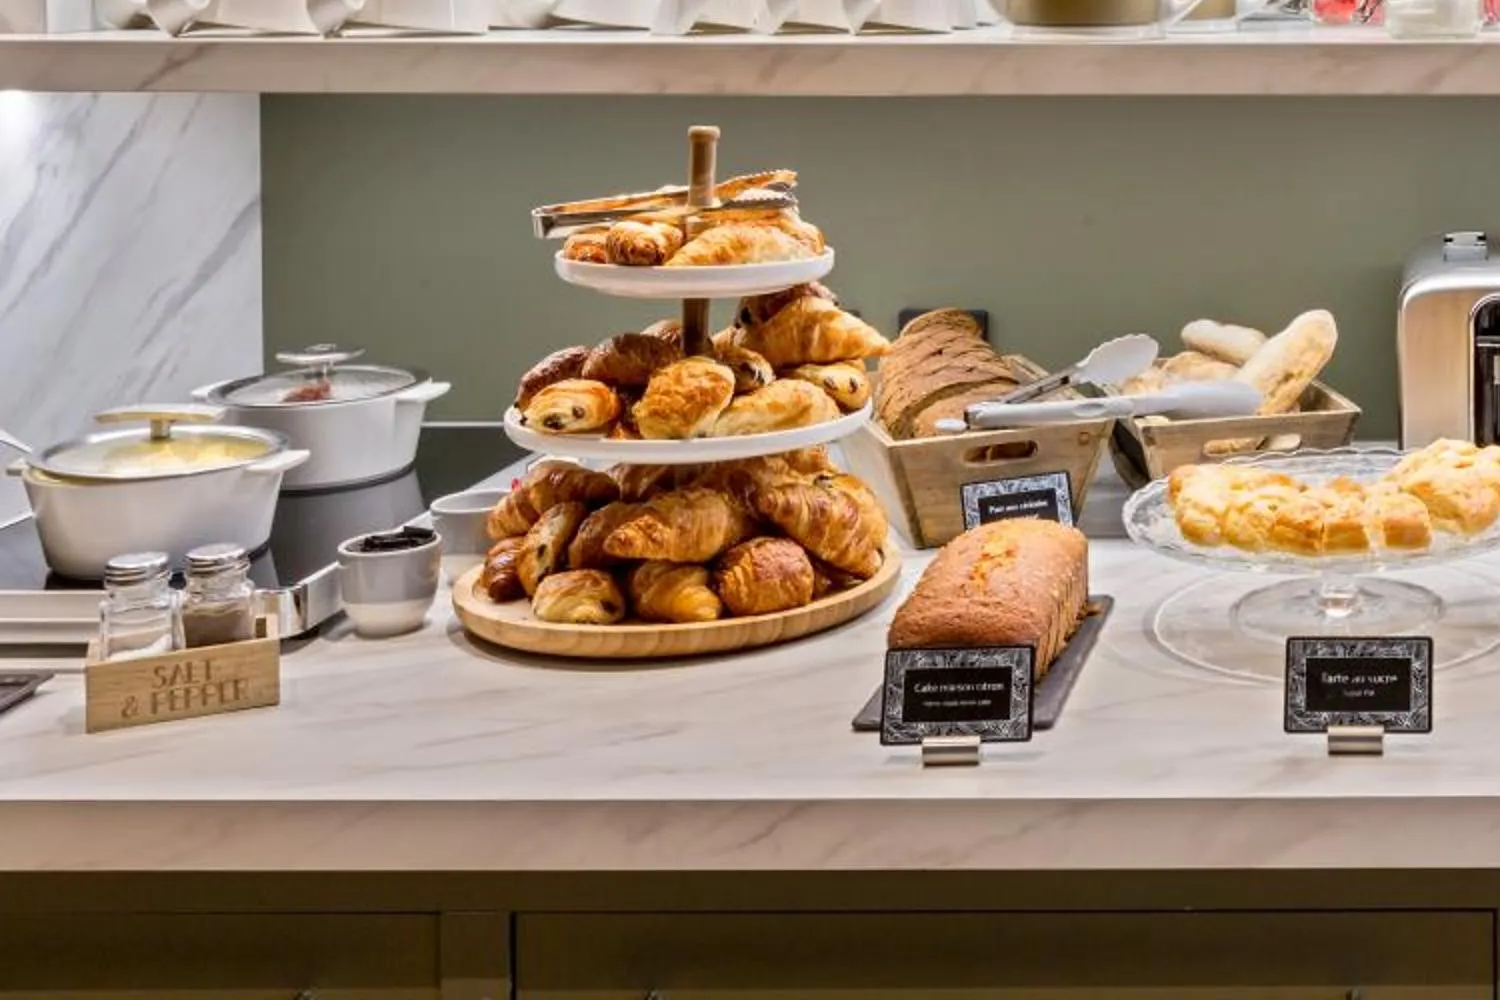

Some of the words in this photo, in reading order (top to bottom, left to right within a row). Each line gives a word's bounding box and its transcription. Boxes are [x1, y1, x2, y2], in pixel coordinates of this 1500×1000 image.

[151, 659, 216, 690] SALT
[1321, 671, 1350, 684] Tarte
[1351, 674, 1365, 683] au
[1367, 674, 1399, 684] sucre
[120, 695, 140, 719] &
[150, 678, 249, 716] PEPPER
[913, 682, 939, 694] Cake
